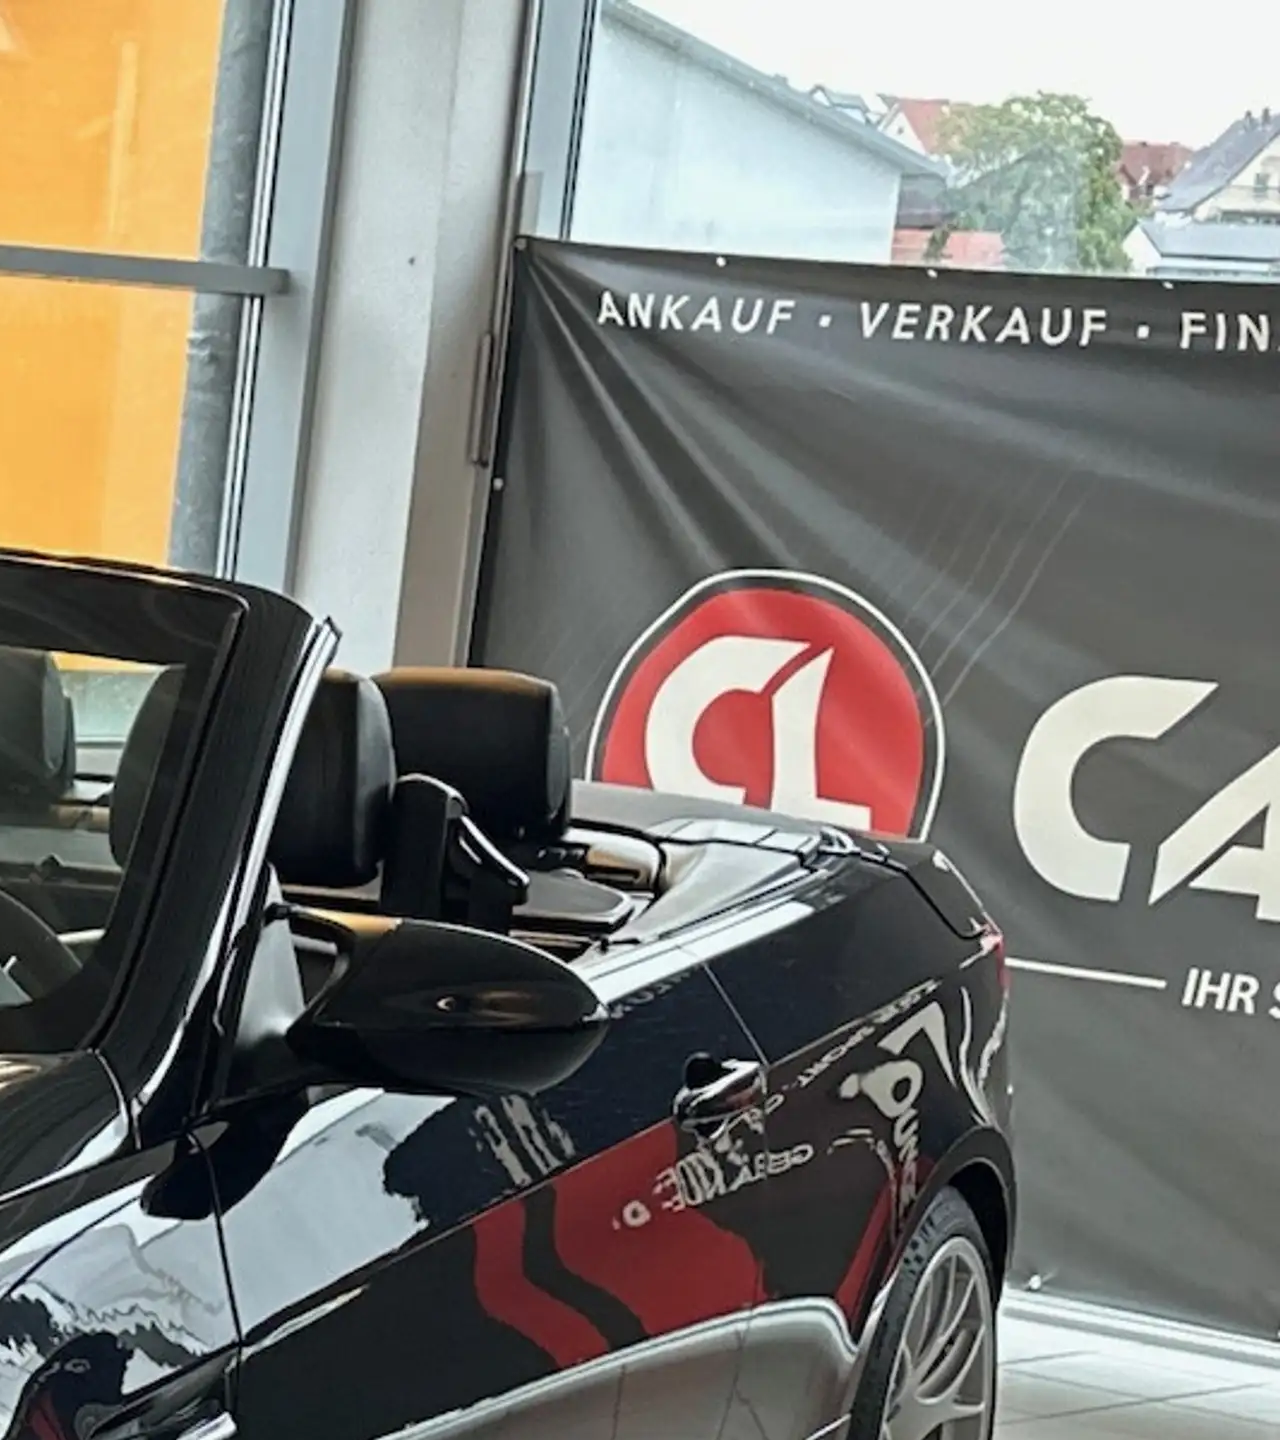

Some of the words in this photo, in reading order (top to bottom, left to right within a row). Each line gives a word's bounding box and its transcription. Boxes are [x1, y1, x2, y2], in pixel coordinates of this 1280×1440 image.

[597, 291, 795, 335] ANKAUF
[860, 302, 1108, 348] VERKAUF
[1179, 311, 1280, 352] FIN
[644, 634, 873, 830] CL
[1181, 966, 1260, 1015] IHR
